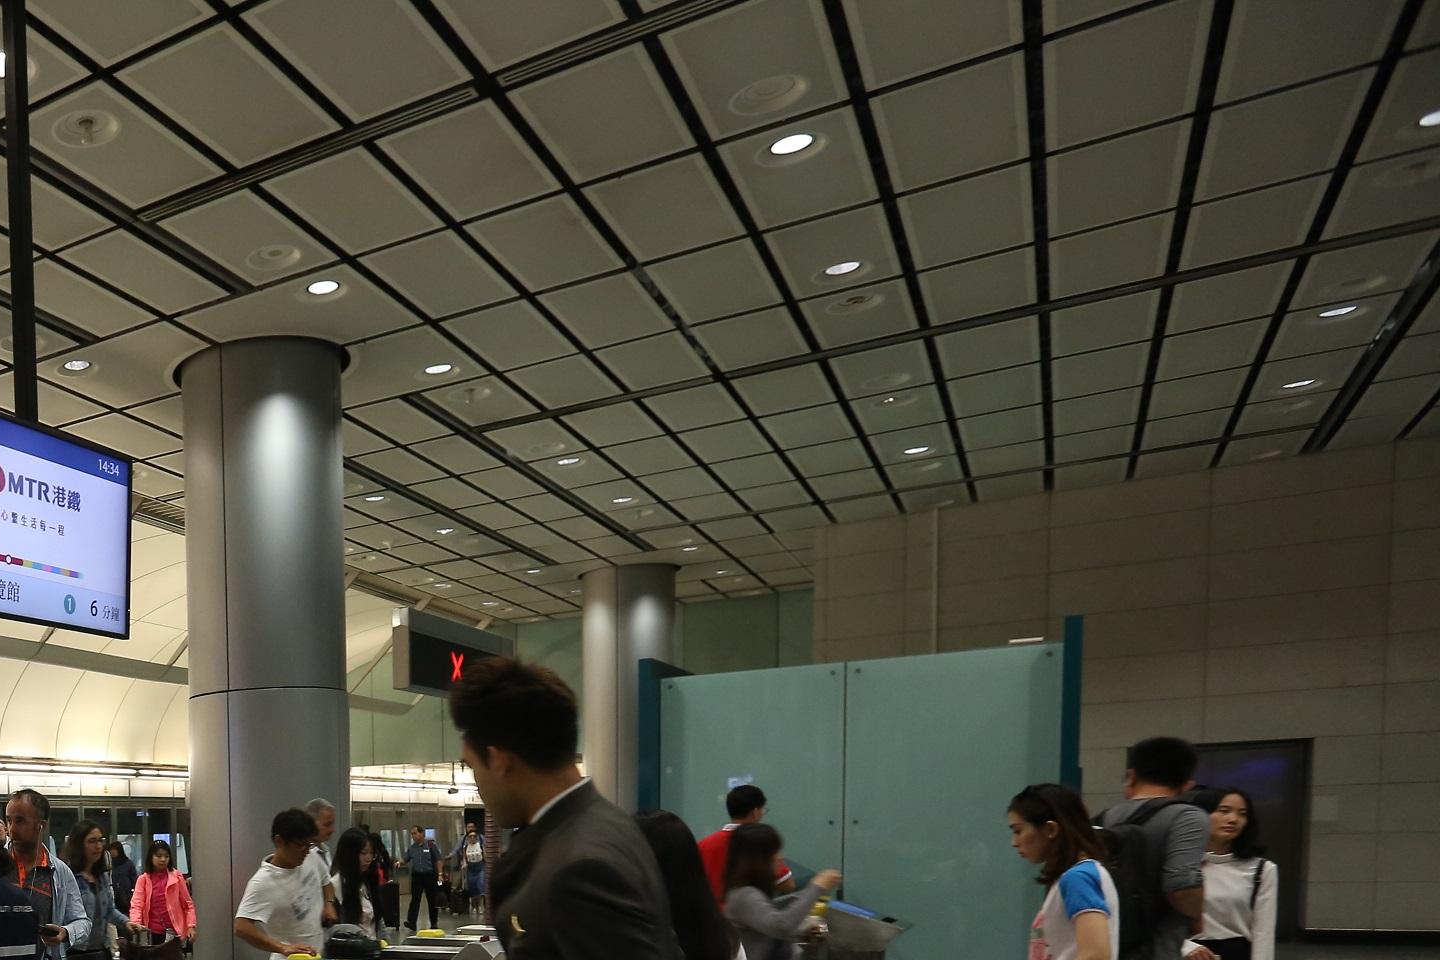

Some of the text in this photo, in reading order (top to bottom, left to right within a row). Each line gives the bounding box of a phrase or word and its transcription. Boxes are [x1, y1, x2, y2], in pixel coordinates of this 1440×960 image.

[98, 458, 120, 477] 14:34
[8, 471, 50, 503] MTR
[90, 601, 98, 617] 6
